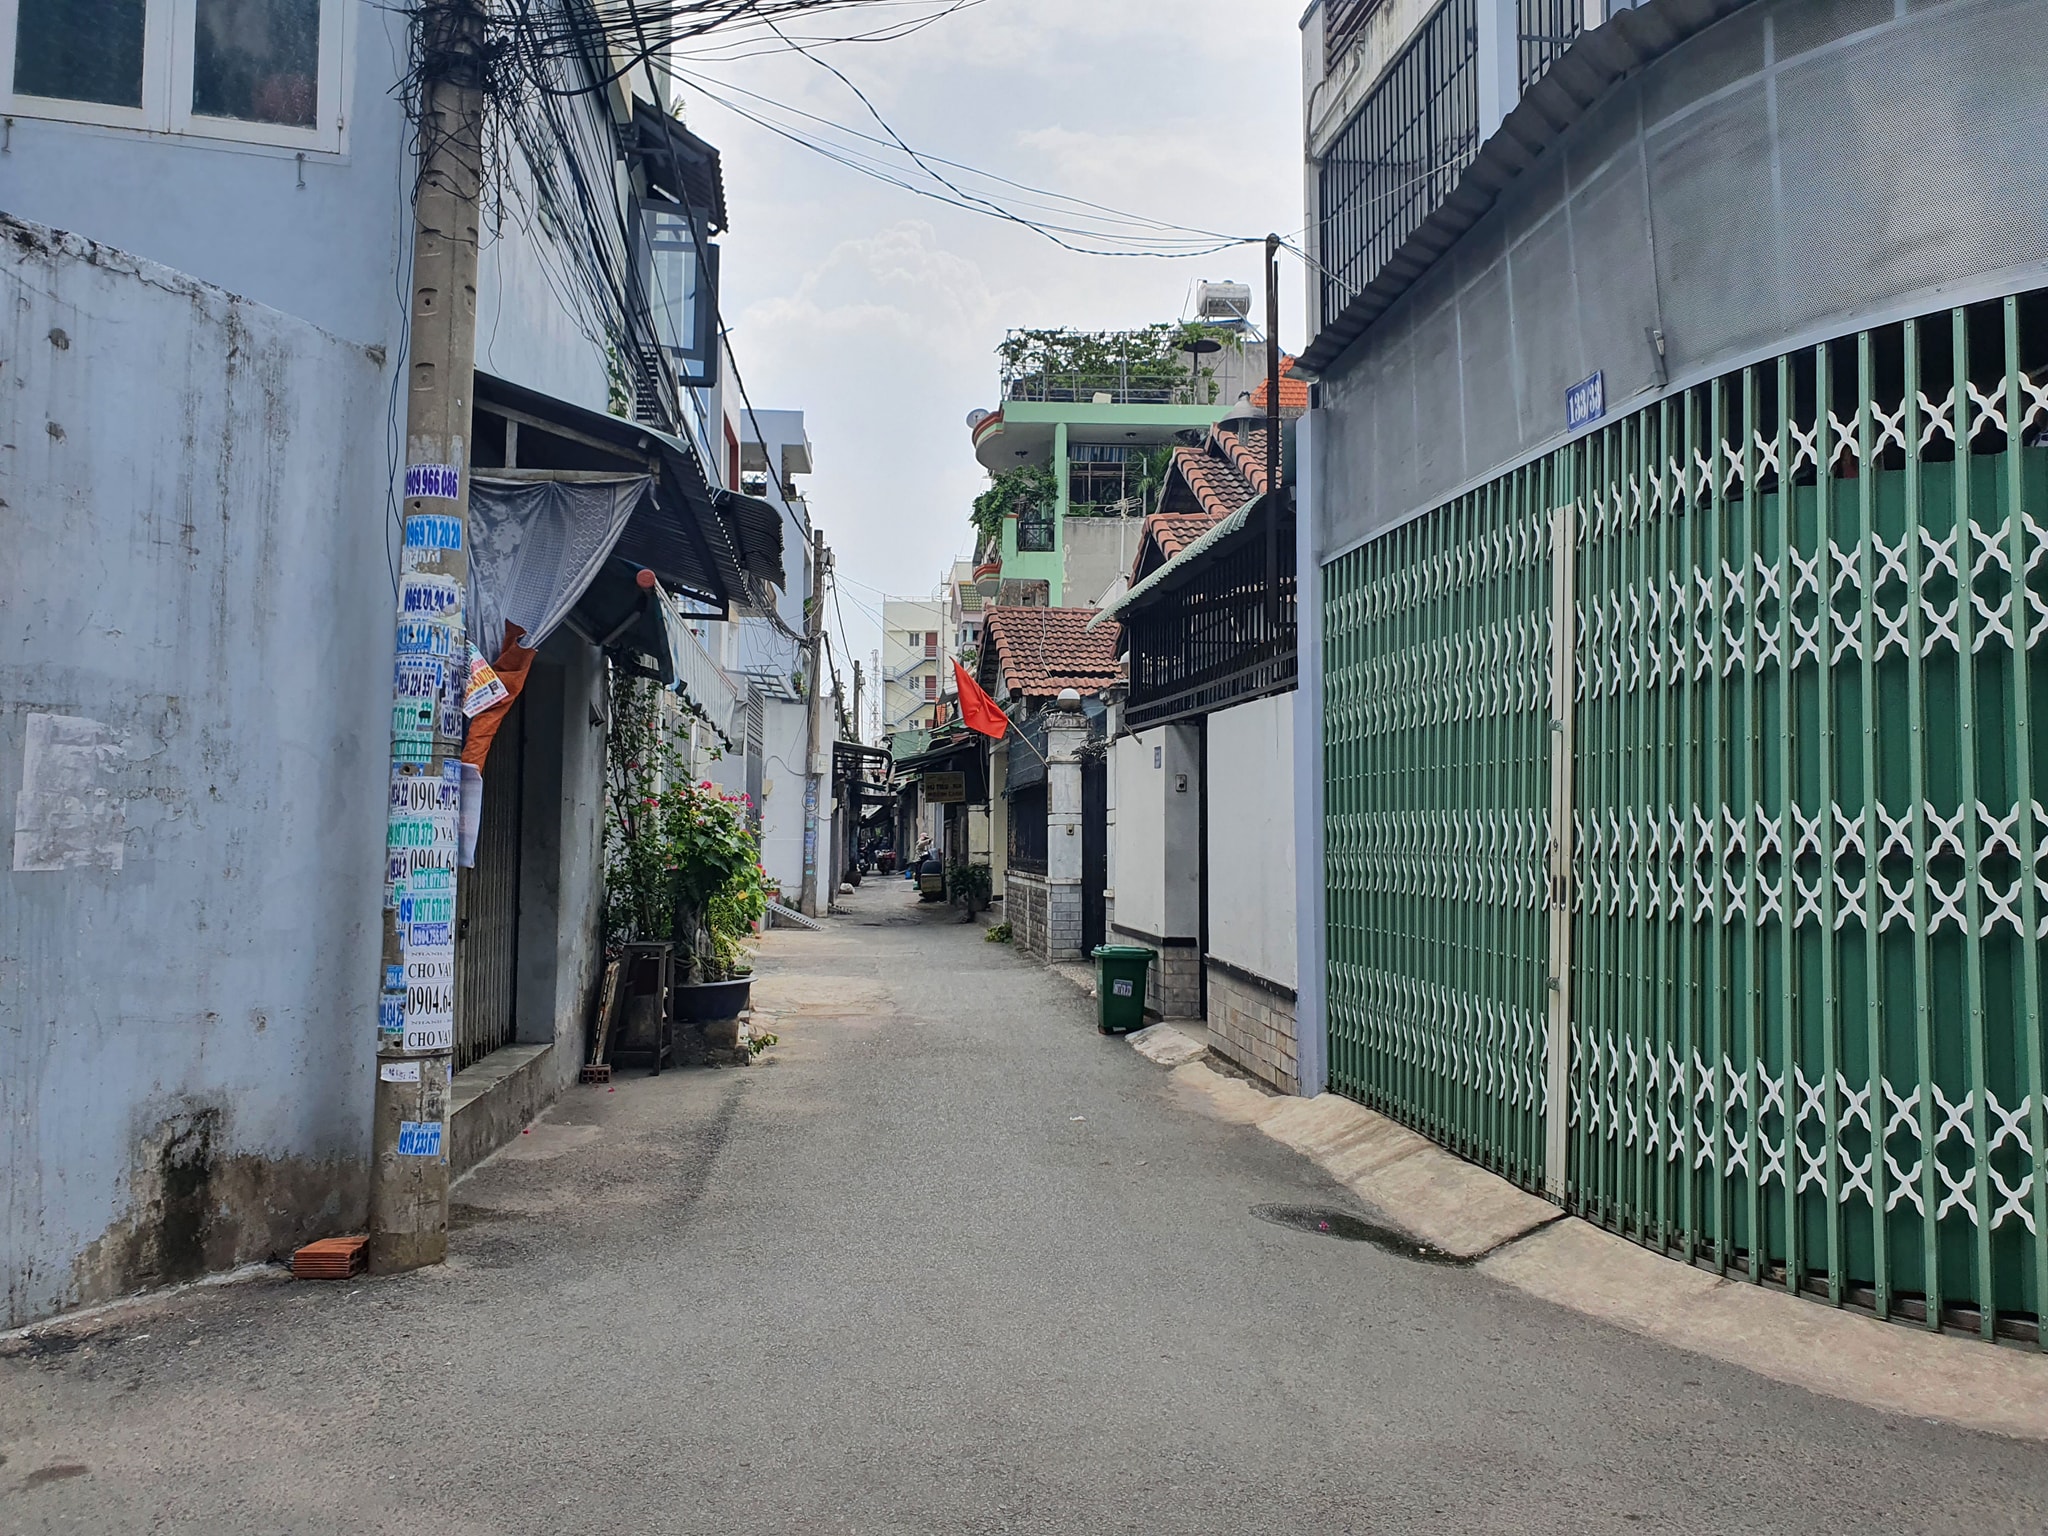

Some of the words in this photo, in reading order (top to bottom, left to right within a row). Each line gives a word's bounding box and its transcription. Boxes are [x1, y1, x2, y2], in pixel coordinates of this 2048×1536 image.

[1569, 379, 1600, 424] 133/33
[408, 963, 435, 978] CHO
[408, 1031, 435, 1047] CHO
